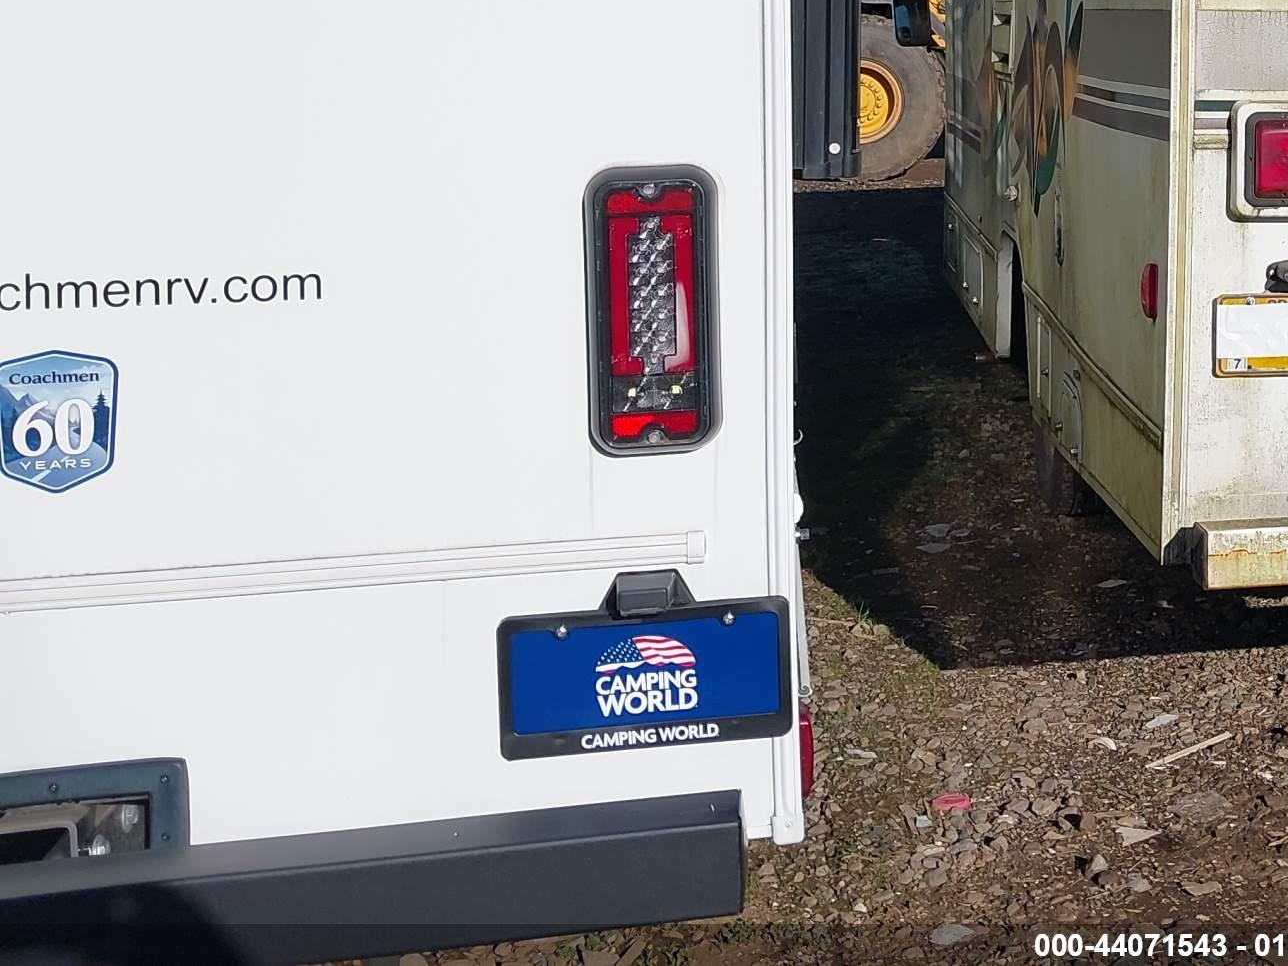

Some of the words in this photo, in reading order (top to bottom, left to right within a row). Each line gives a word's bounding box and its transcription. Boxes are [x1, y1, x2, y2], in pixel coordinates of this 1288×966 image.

[0, 272, 322, 311] chmenrv.com
[8, 370, 100, 386] Coachmen
[12, 398, 95, 457] 60
[20, 457, 91, 471] YEARS
[595, 669, 697, 696] CAMPING
[597, 685, 698, 717] WORLD
[581, 728, 657, 749] CAMPING
[660, 723, 719, 742] WORLD
